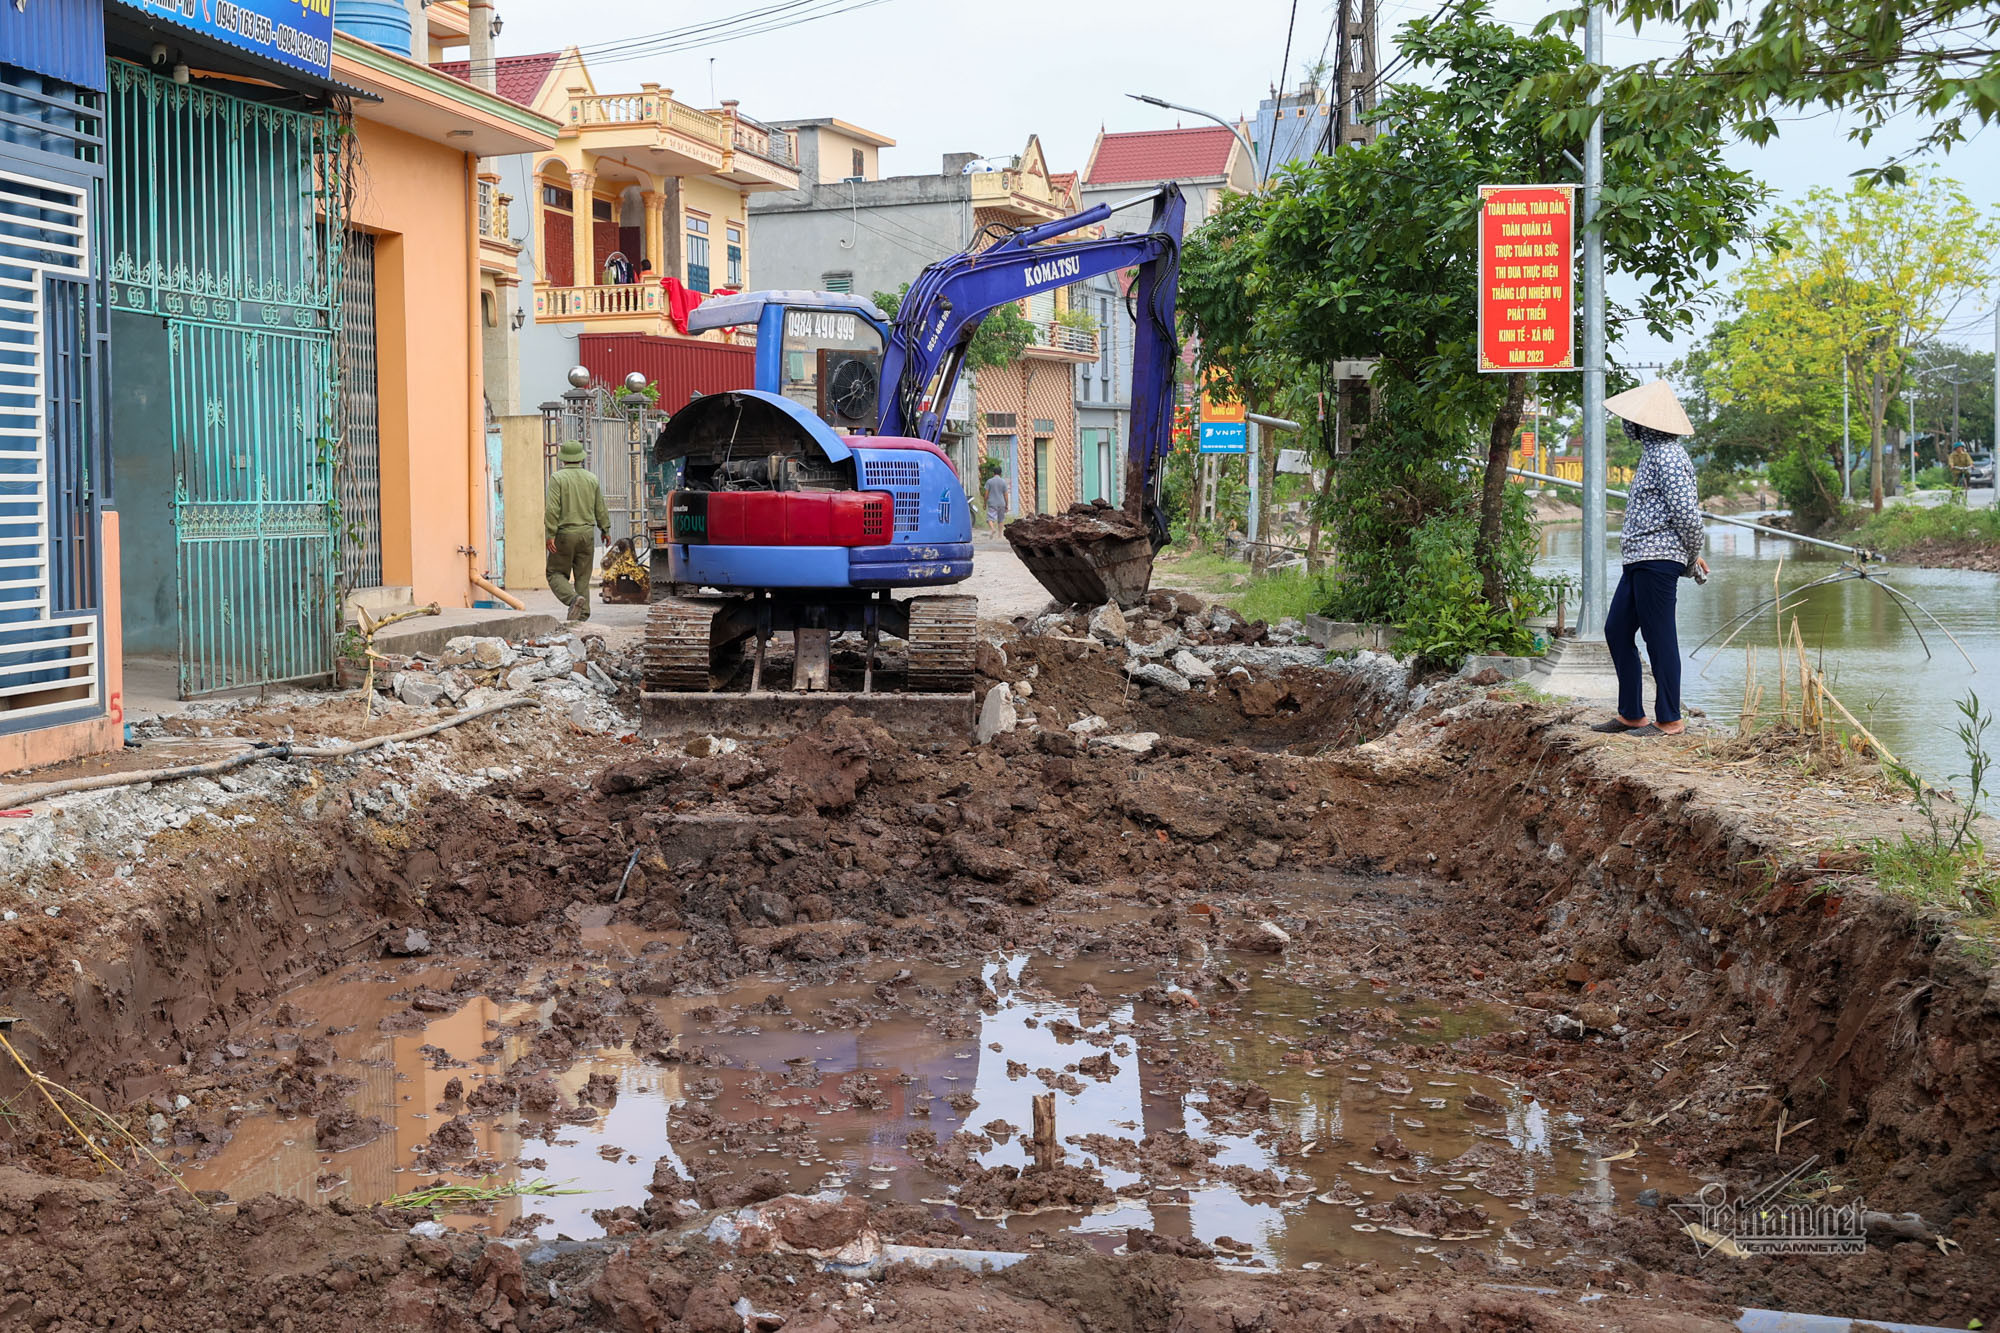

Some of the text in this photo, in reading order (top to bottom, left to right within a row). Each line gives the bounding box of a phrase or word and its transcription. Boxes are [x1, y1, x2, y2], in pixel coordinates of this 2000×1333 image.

[215, 1, 238, 32] 0945
[239, 8, 255, 39] 163
[255, 14, 272, 45] 556
[277, 24, 297, 55] 0984
[298, 32, 313, 62] 932
[313, 38, 328, 67] 603
[1488, 198, 1566, 216] TOÀN ĐẢNG, TOÀN DÂN,
[1502, 220, 1552, 237] TOÀN QUÂN XÃ
[1495, 240, 1559, 260] TRỰC TUẤN RA SỨC
[1024, 255, 1080, 287] KOMATSU
[1495, 263, 1558, 280] THI ĐUA THỰC HIỆN
[1492, 283, 1562, 302] THẮNG LỢI NHIỆM VỤ
[1507, 303, 1547, 320] PHÁT TRIỂN
[788, 312, 855, 341] 0984 490 999
[1499, 329, 1516, 342] KINH
[1517, 325, 1527, 342] TẾ
[1531, 326, 1541, 341] XÃ
[1542, 326, 1555, 344] HỘI
[1509, 348, 1544, 363] NĂM 2023
[110, 693, 123, 726] 5
